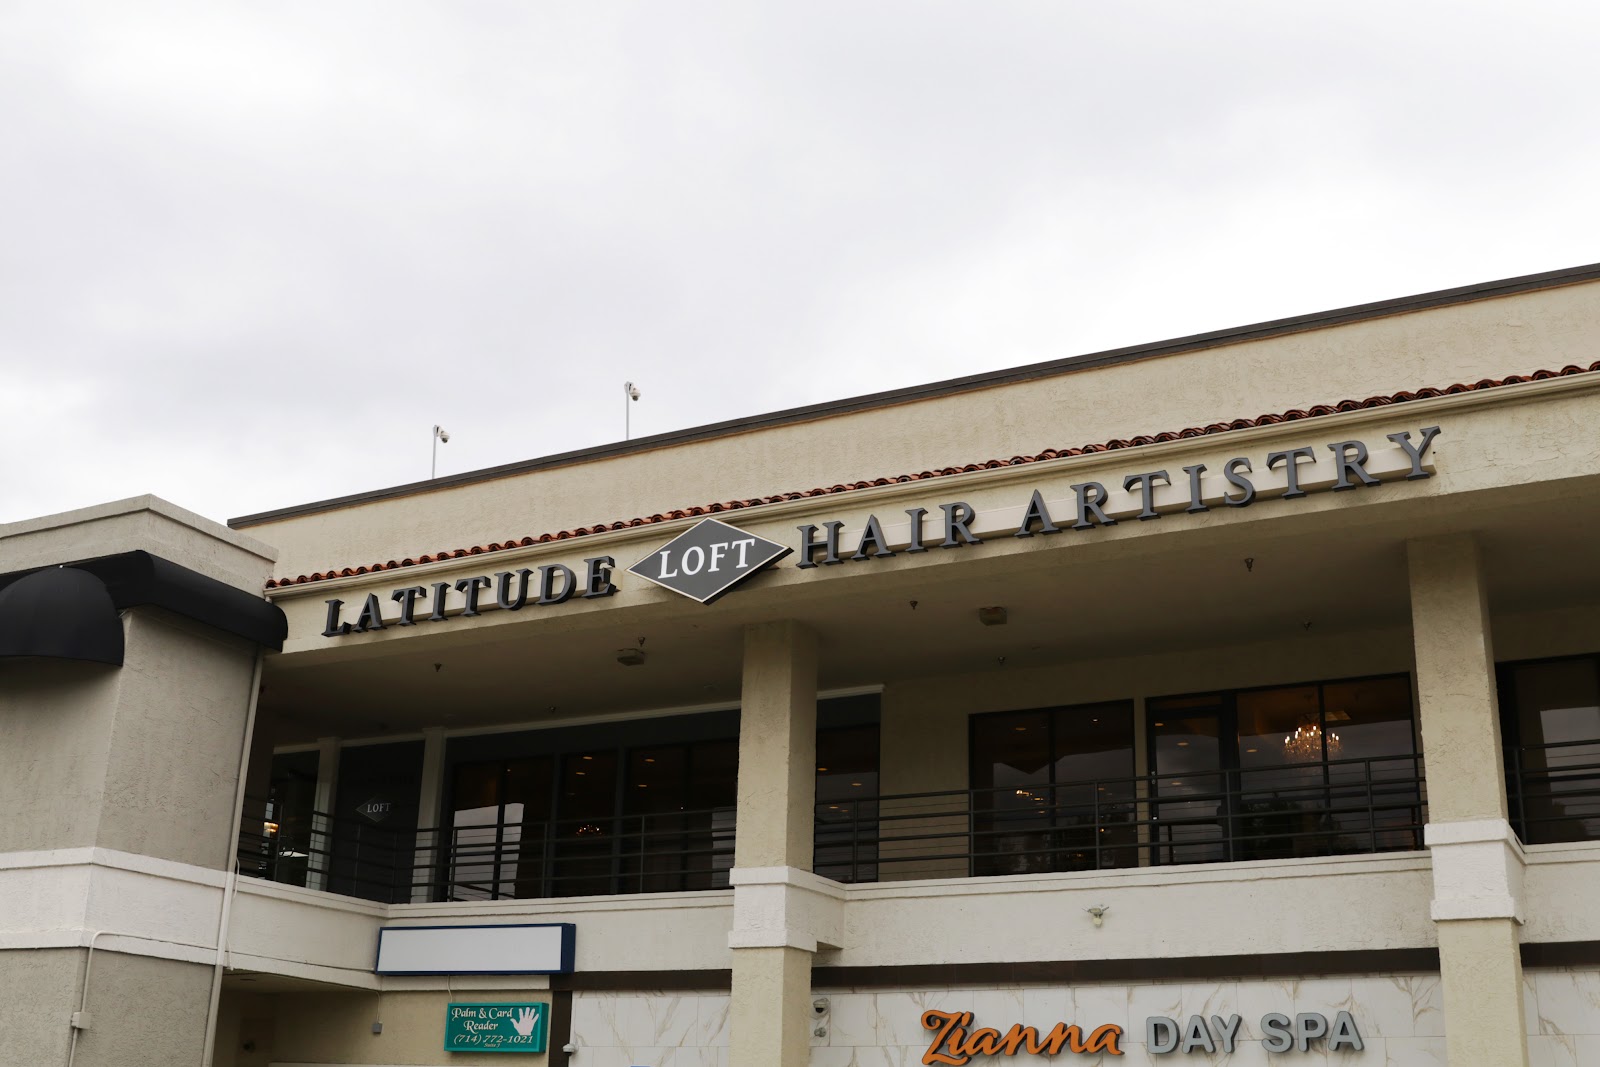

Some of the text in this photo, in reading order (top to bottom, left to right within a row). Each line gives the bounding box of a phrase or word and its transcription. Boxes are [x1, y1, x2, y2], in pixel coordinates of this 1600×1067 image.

[795, 425, 1442, 569] HAIR ARTISTRY
[657, 538, 756, 579] LOFT
[321, 555, 617, 637] LATITUDE
[367, 802, 391, 813] LOFT
[451, 1007, 514, 1021] Palm & Card
[463, 1020, 499, 1034] Reader
[453, 1033, 534, 1045] (714) 772-1021
[920, 1009, 1364, 1066] Zianna DAY SPA
